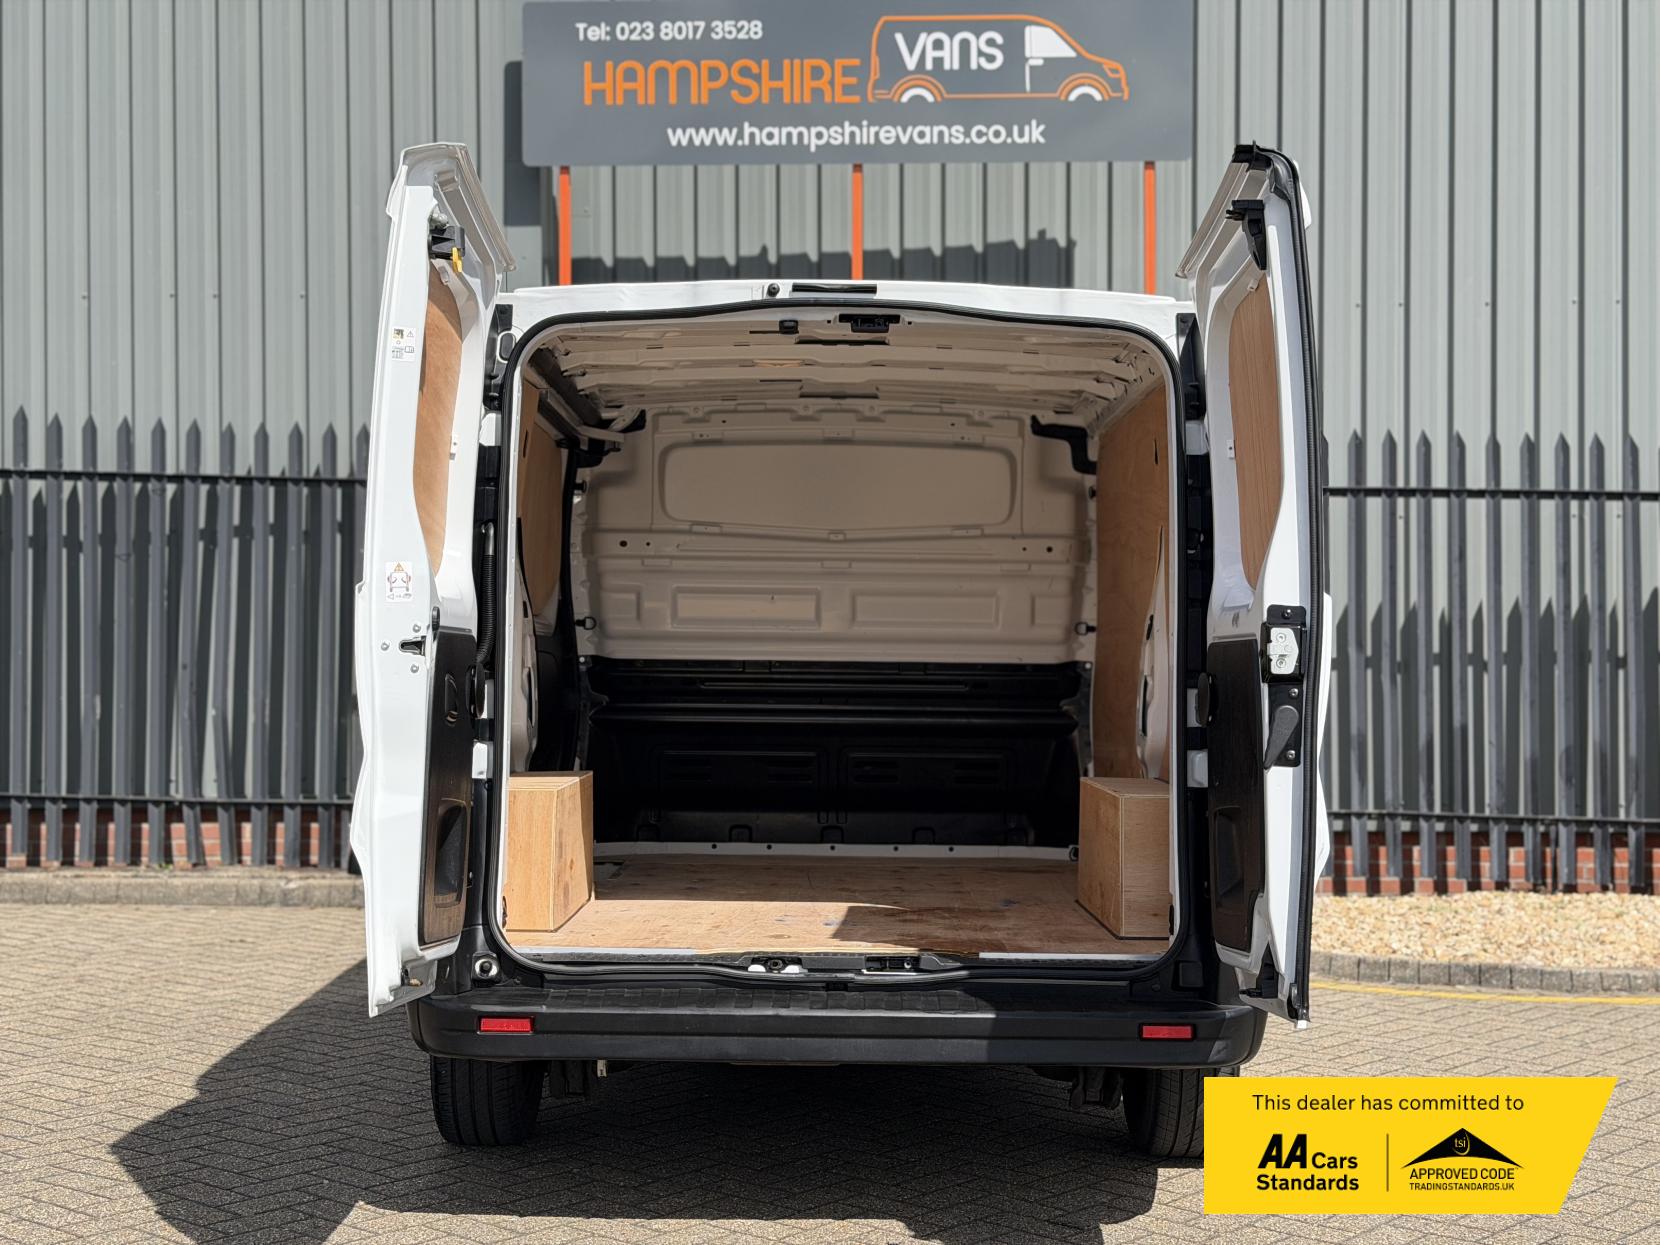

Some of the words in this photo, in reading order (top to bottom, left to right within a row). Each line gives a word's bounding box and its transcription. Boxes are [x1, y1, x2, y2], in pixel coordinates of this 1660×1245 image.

[575, 22, 611, 42] Tel:
[616, 22, 655, 42] 023
[659, 21, 706, 41] 8017
[710, 20, 763, 40] 3528
[583, 58, 861, 105] HAMPSHIRE
[894, 31, 1004, 71] VANS
[667, 120, 1046, 152] www.hampshirevans.co.uk
